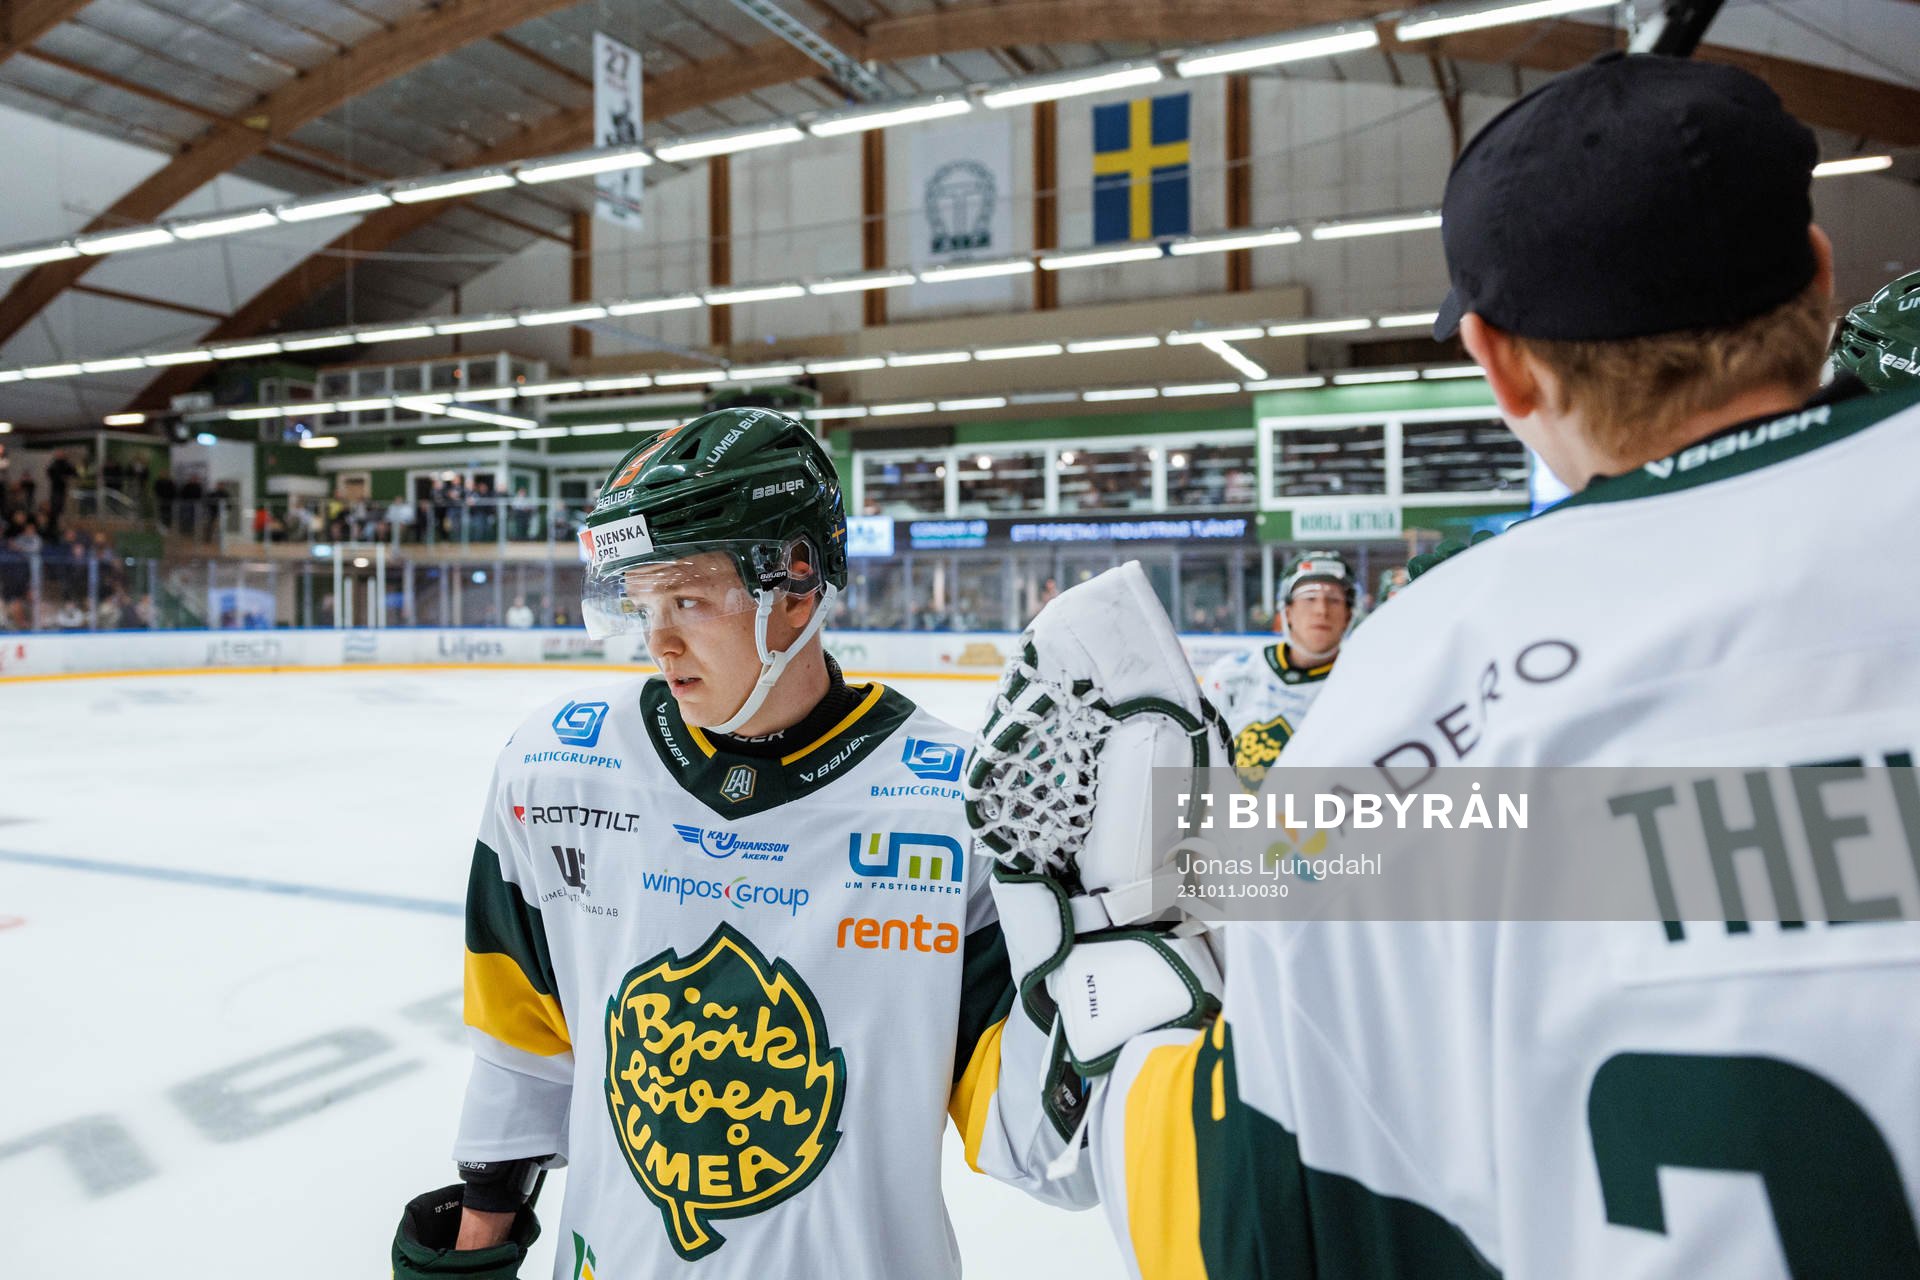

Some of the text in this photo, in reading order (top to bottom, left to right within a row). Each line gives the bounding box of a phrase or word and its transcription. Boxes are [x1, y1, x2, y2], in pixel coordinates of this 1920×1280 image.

[1676, 404, 1831, 472] BAUER
[752, 479, 805, 500] BAUER
[595, 525, 645, 548] SVENSKA
[657, 715, 691, 768] BAUER
[524, 751, 622, 770] BALTICGRUPPEN
[707, 830, 790, 853] KAJ JOHANSSON
[741, 852, 770, 861] ÅKERI
[845, 882, 962, 895] UM FASTIGHETER
[606, 907, 619, 918] AB
[836, 914, 960, 954] renta
[1086, 974, 1098, 1019] THELIN
[626, 1103, 790, 1197] UMEÅ
